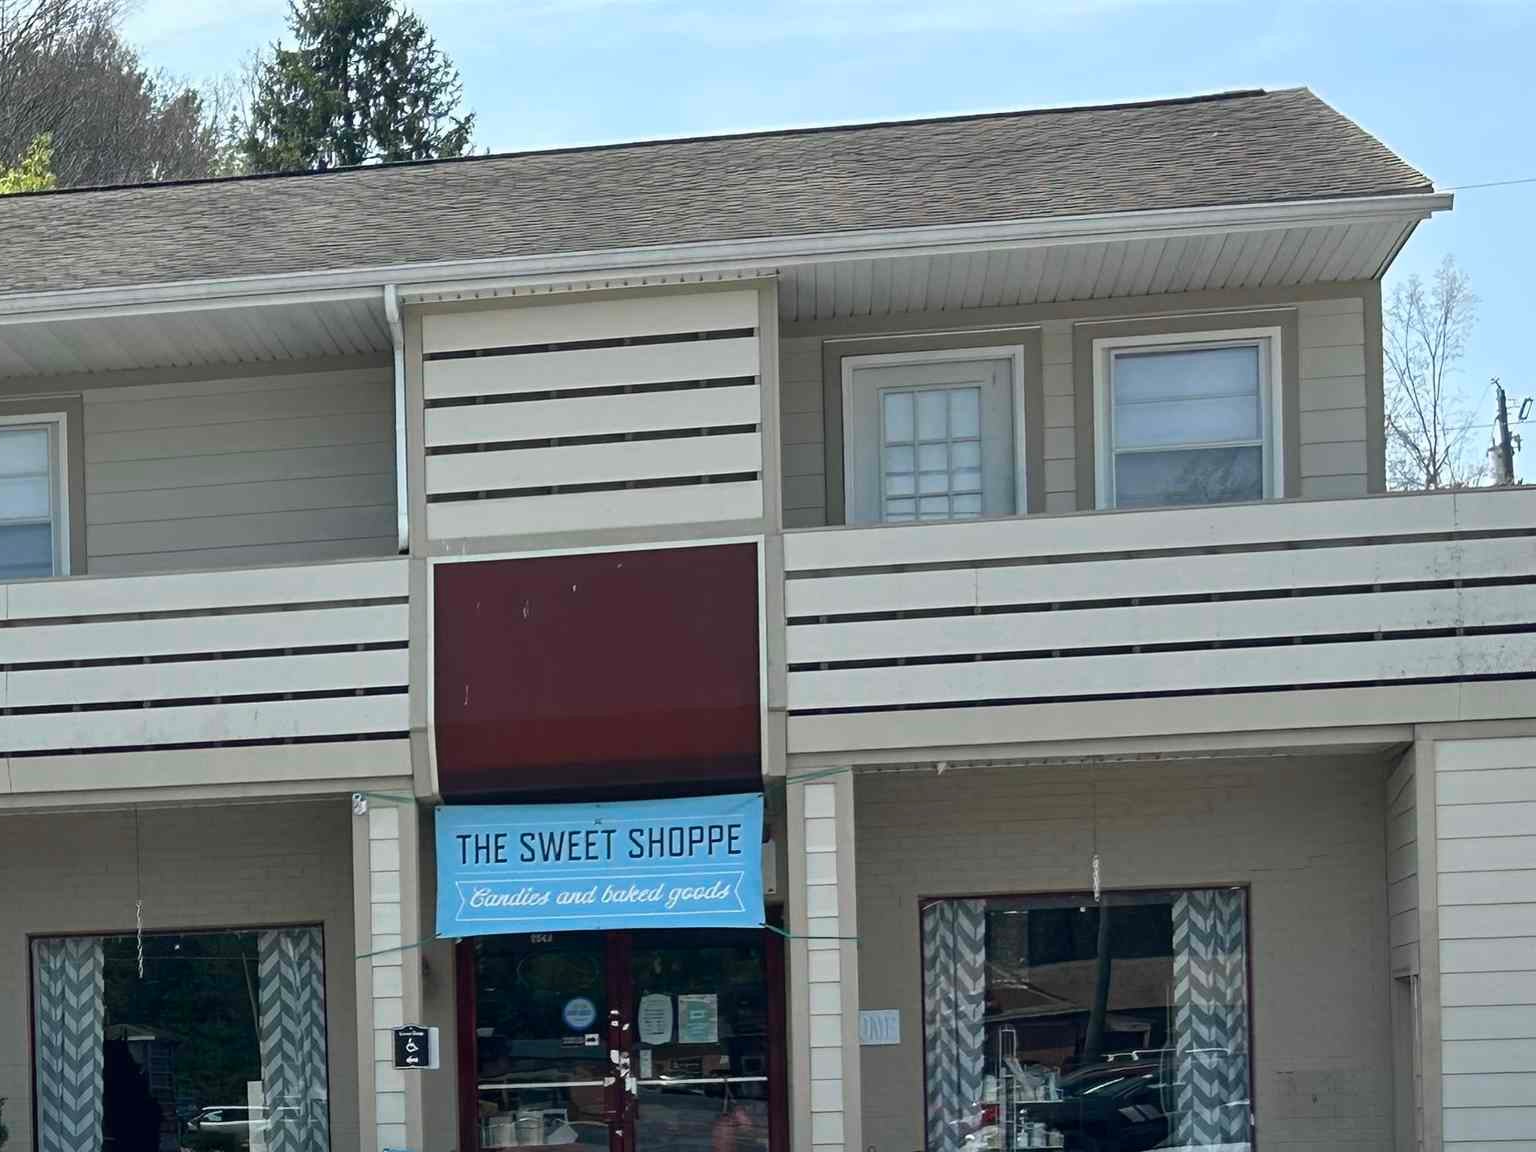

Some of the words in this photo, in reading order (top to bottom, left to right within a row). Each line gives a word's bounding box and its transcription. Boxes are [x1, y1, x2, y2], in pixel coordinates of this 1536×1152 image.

[456, 832, 509, 865] THE
[520, 829, 617, 863] SWEET
[628, 824, 743, 860] SHOPPE
[470, 885, 551, 909] Candies
[556, 886, 597, 906] and
[601, 882, 664, 904] baked
[665, 880, 731, 910] goods
